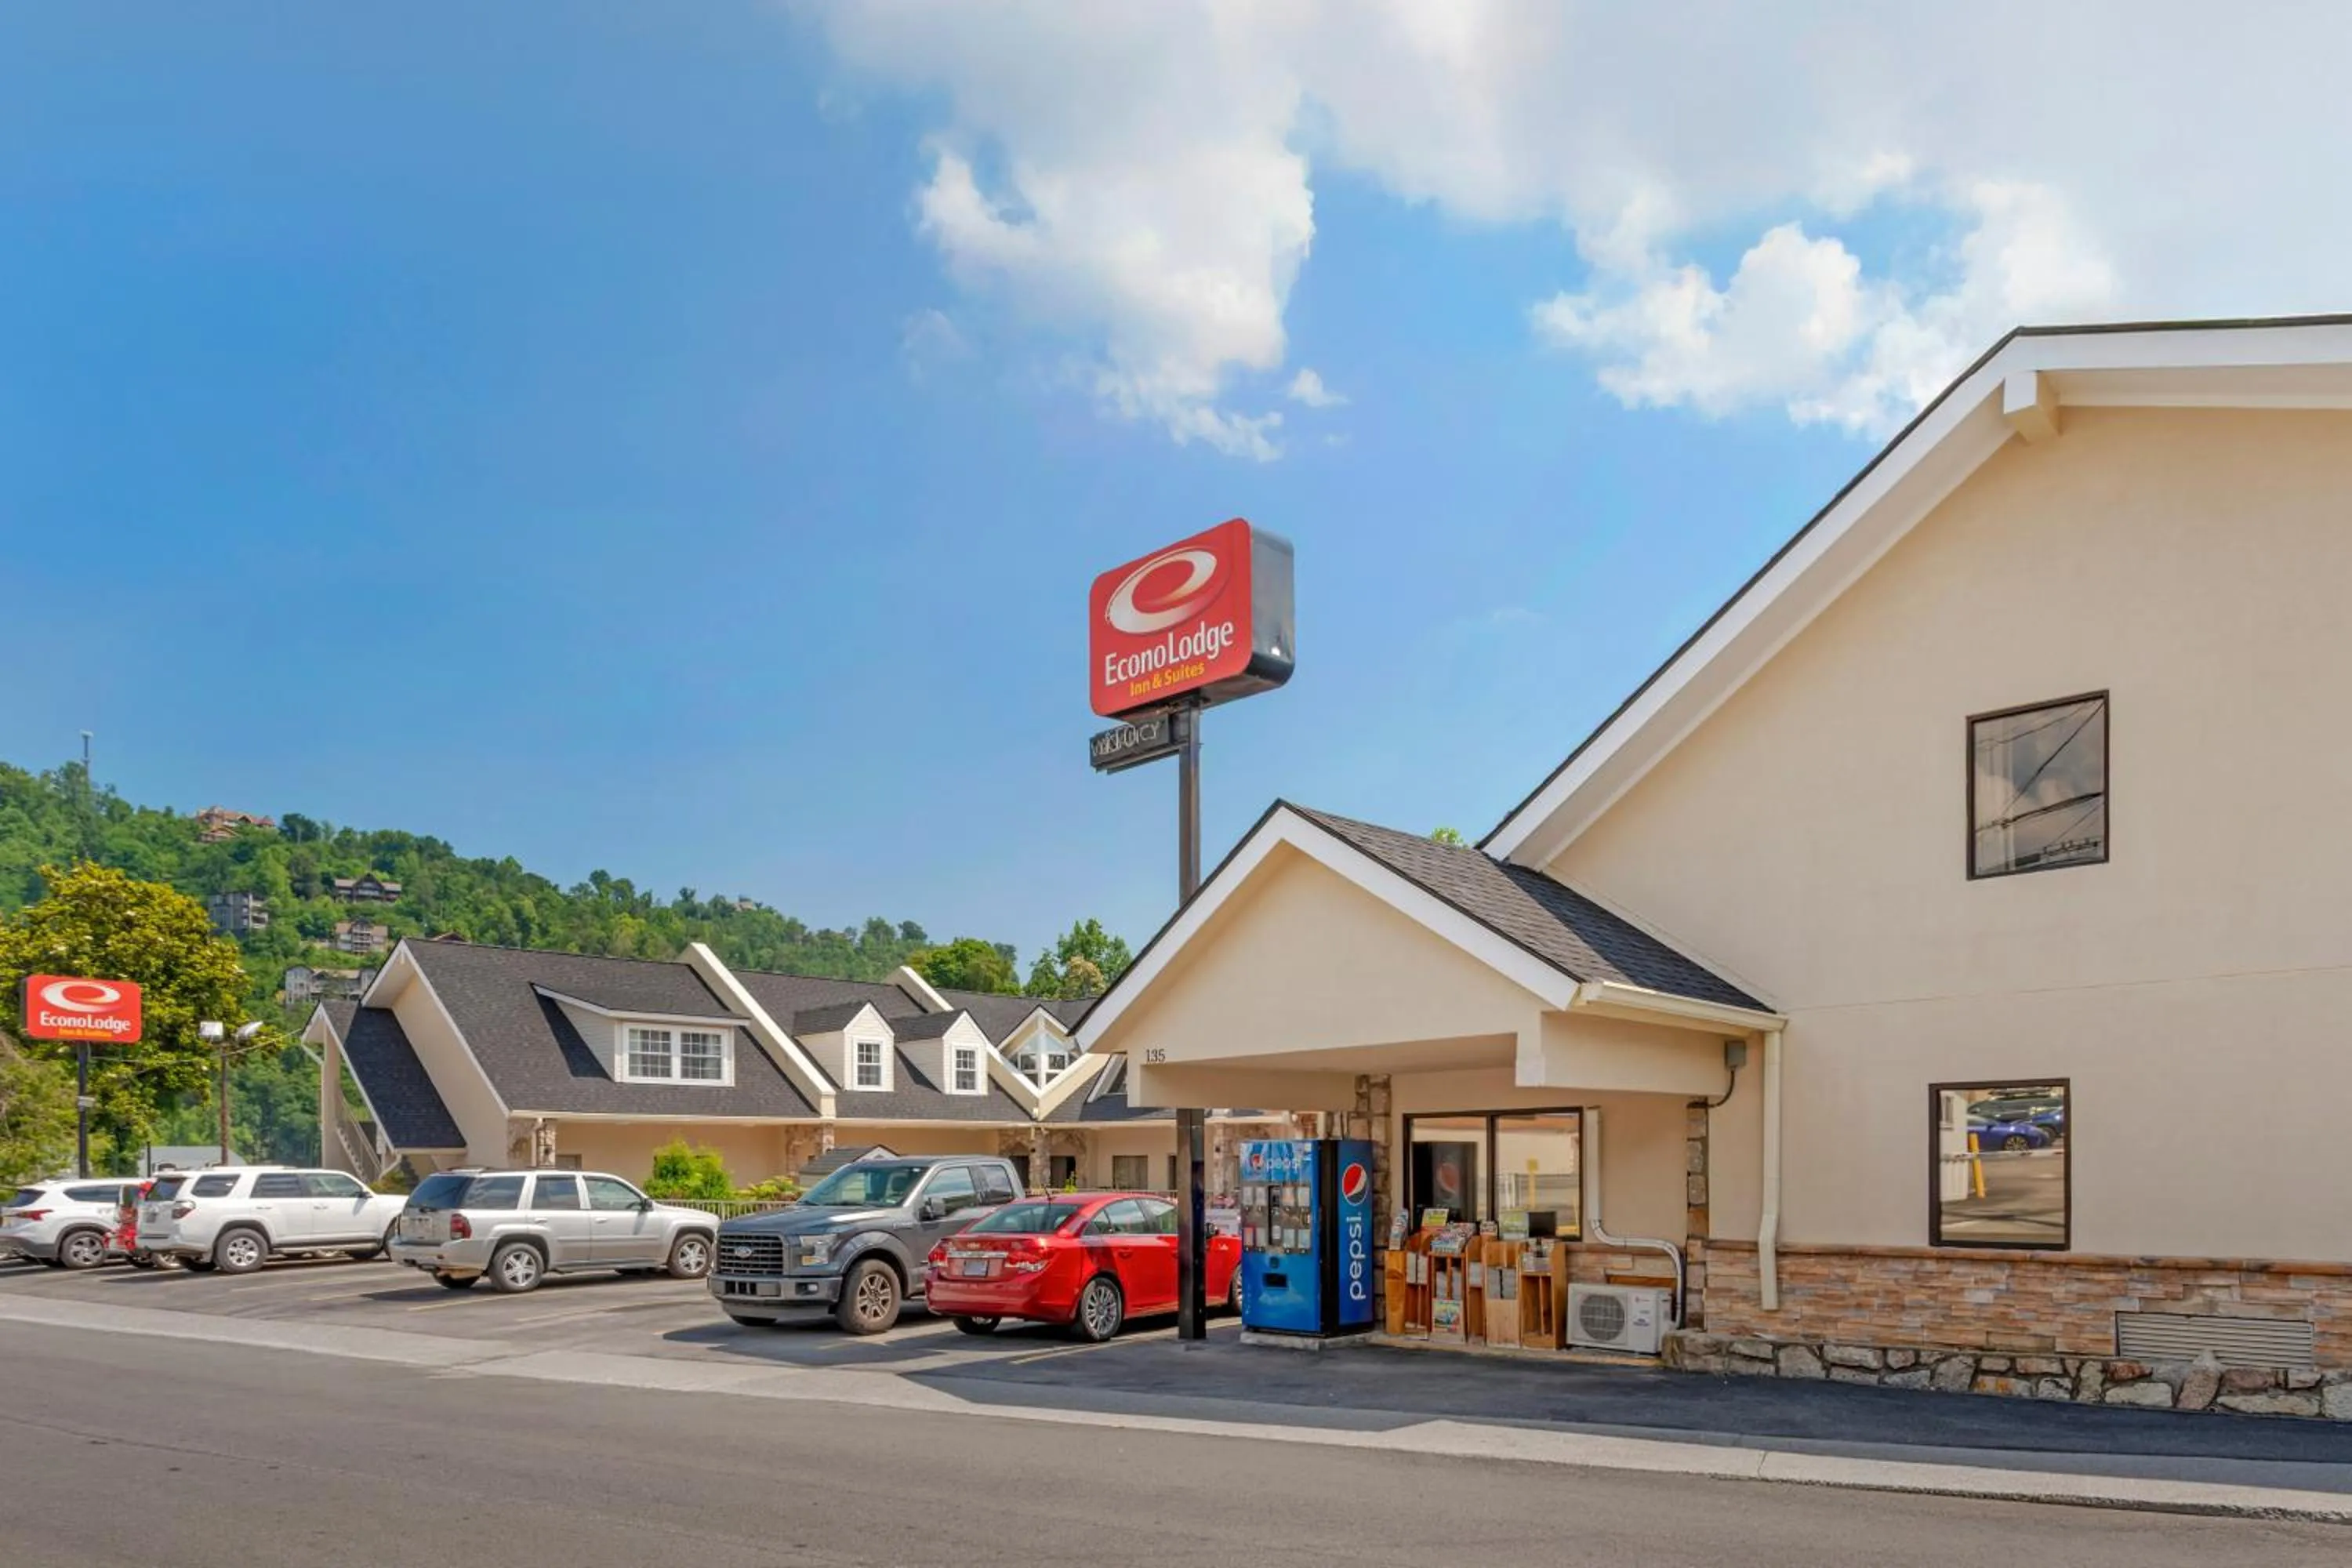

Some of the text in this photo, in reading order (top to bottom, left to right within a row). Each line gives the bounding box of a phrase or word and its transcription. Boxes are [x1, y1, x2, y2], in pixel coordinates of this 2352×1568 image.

[1104, 620, 1234, 686] EconoLodge
[1130, 662, 1205, 697] Inn & Suites
[39, 1011, 132, 1033] EconoLodge
[1146, 1048, 1166, 1062] 135
[1346, 1216, 1367, 1301] pepsi
